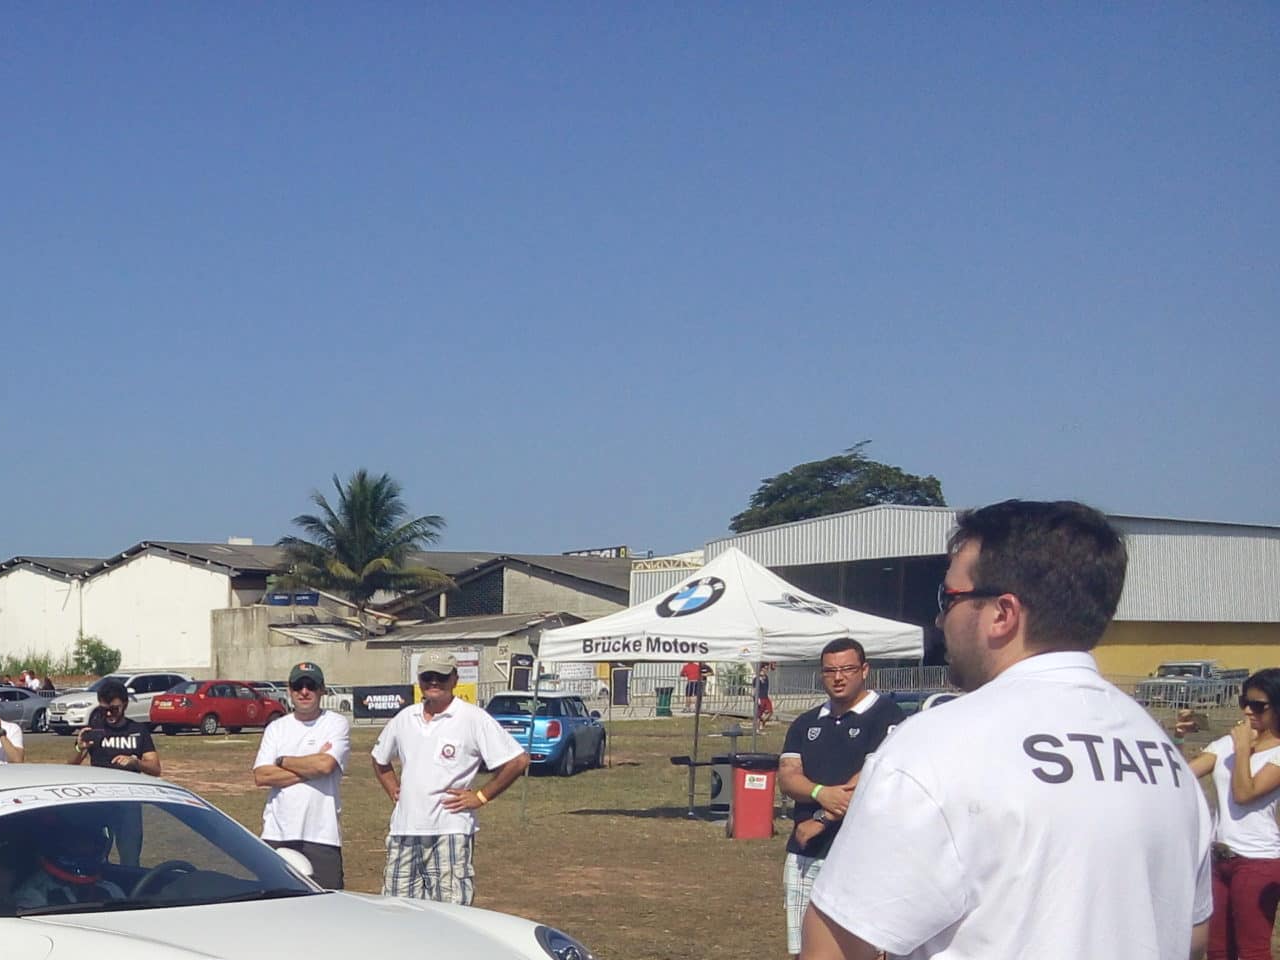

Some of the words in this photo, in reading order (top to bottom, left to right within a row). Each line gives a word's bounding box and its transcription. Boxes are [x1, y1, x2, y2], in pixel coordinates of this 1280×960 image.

[582, 637, 642, 653] Brücke
[646, 637, 709, 654] Motors
[101, 736, 137, 749] MINI
[1022, 733, 1182, 788] STAFF
